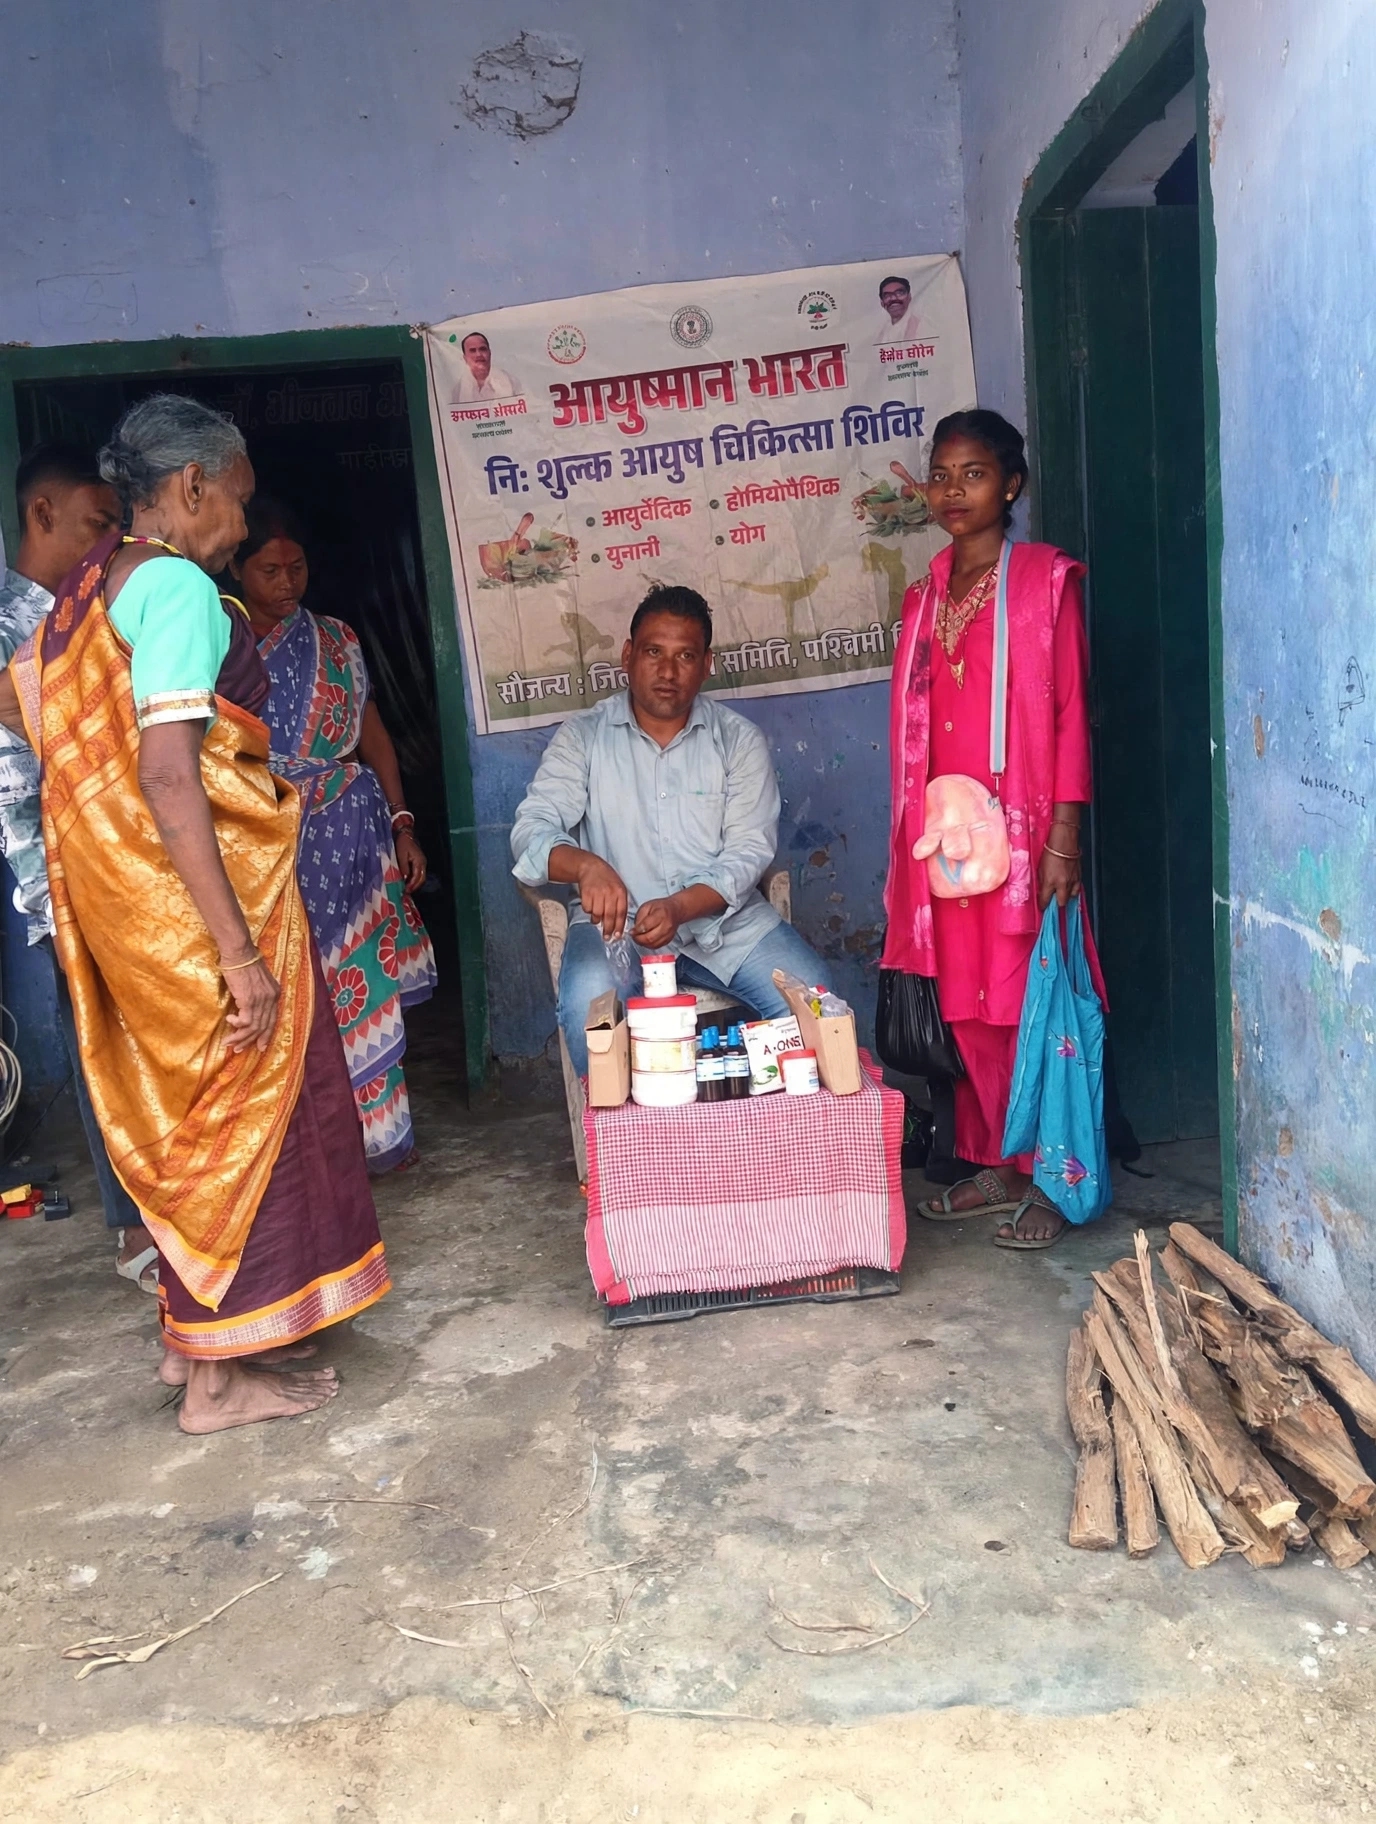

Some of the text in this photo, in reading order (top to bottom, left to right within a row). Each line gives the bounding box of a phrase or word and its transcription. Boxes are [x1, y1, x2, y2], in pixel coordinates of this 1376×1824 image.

[549, 343, 849, 436] आयुष्मान भारत
[536, 451, 612, 499] शुल्क
[620, 437, 704, 484] आयुष
[710, 419, 834, 465] चिकित्सा
[840, 400, 925, 447] शिविर
[724, 475, 840, 511] होमियोपैथिक
[729, 521, 766, 545] योग
[720, 637, 798, 674] समिति,
[801, 622, 887, 662] पश्चिमी
[495, 671, 571, 705] सौजन्य
